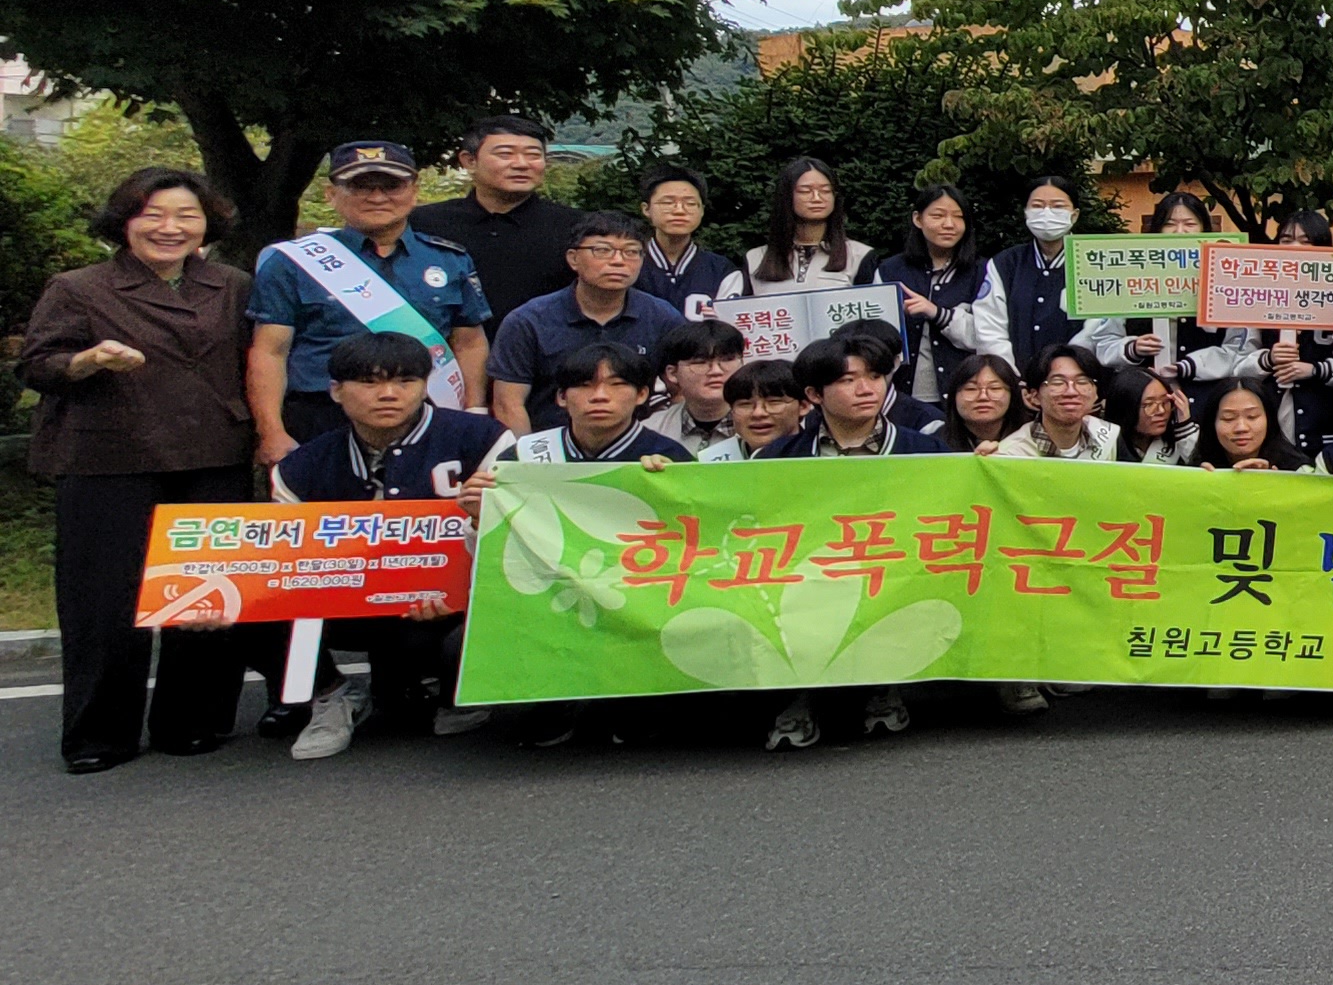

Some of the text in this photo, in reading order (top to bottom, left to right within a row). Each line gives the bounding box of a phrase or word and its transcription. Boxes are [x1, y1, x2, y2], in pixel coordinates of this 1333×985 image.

[1126, 277, 1160, 296] 먼저
[734, 308, 795, 332] 폭력은
[826, 300, 883, 322] 상처는
[167, 515, 465, 549] 금연해서 부자되세요
[616, 503, 1166, 608] 학교폭력근절
[1208, 518, 1274, 606] 및
[1126, 625, 1326, 661] 칠원고등학교
